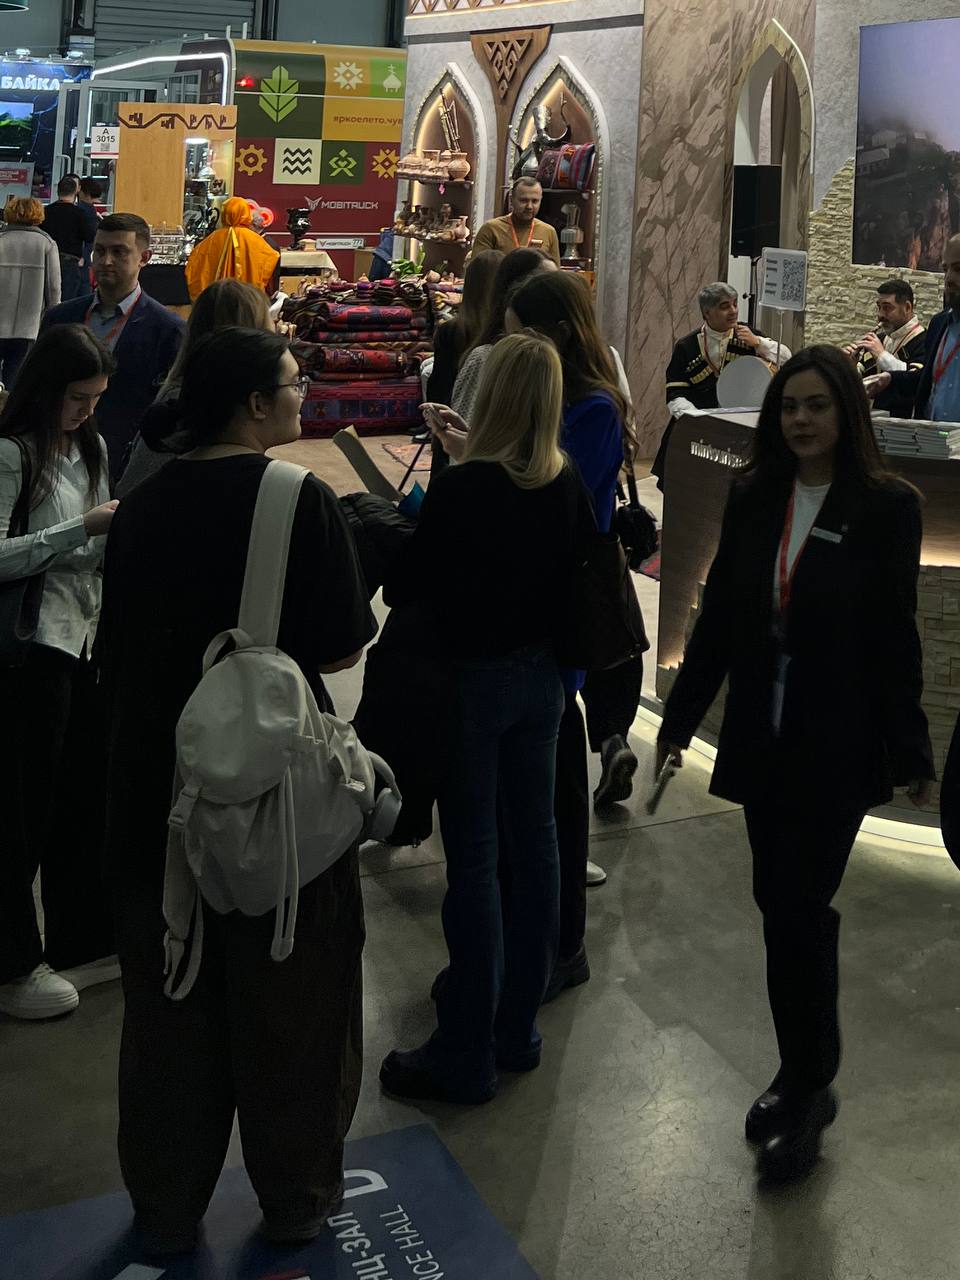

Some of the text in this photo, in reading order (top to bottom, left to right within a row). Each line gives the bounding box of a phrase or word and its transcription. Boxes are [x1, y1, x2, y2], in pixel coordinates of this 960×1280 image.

[1, 74, 75, 91] БАЙКА
[96, 135, 116, 143] 3015
[321, 201, 379, 210] MOBITRUCK
[380, 1203, 425, 1251] HALL
